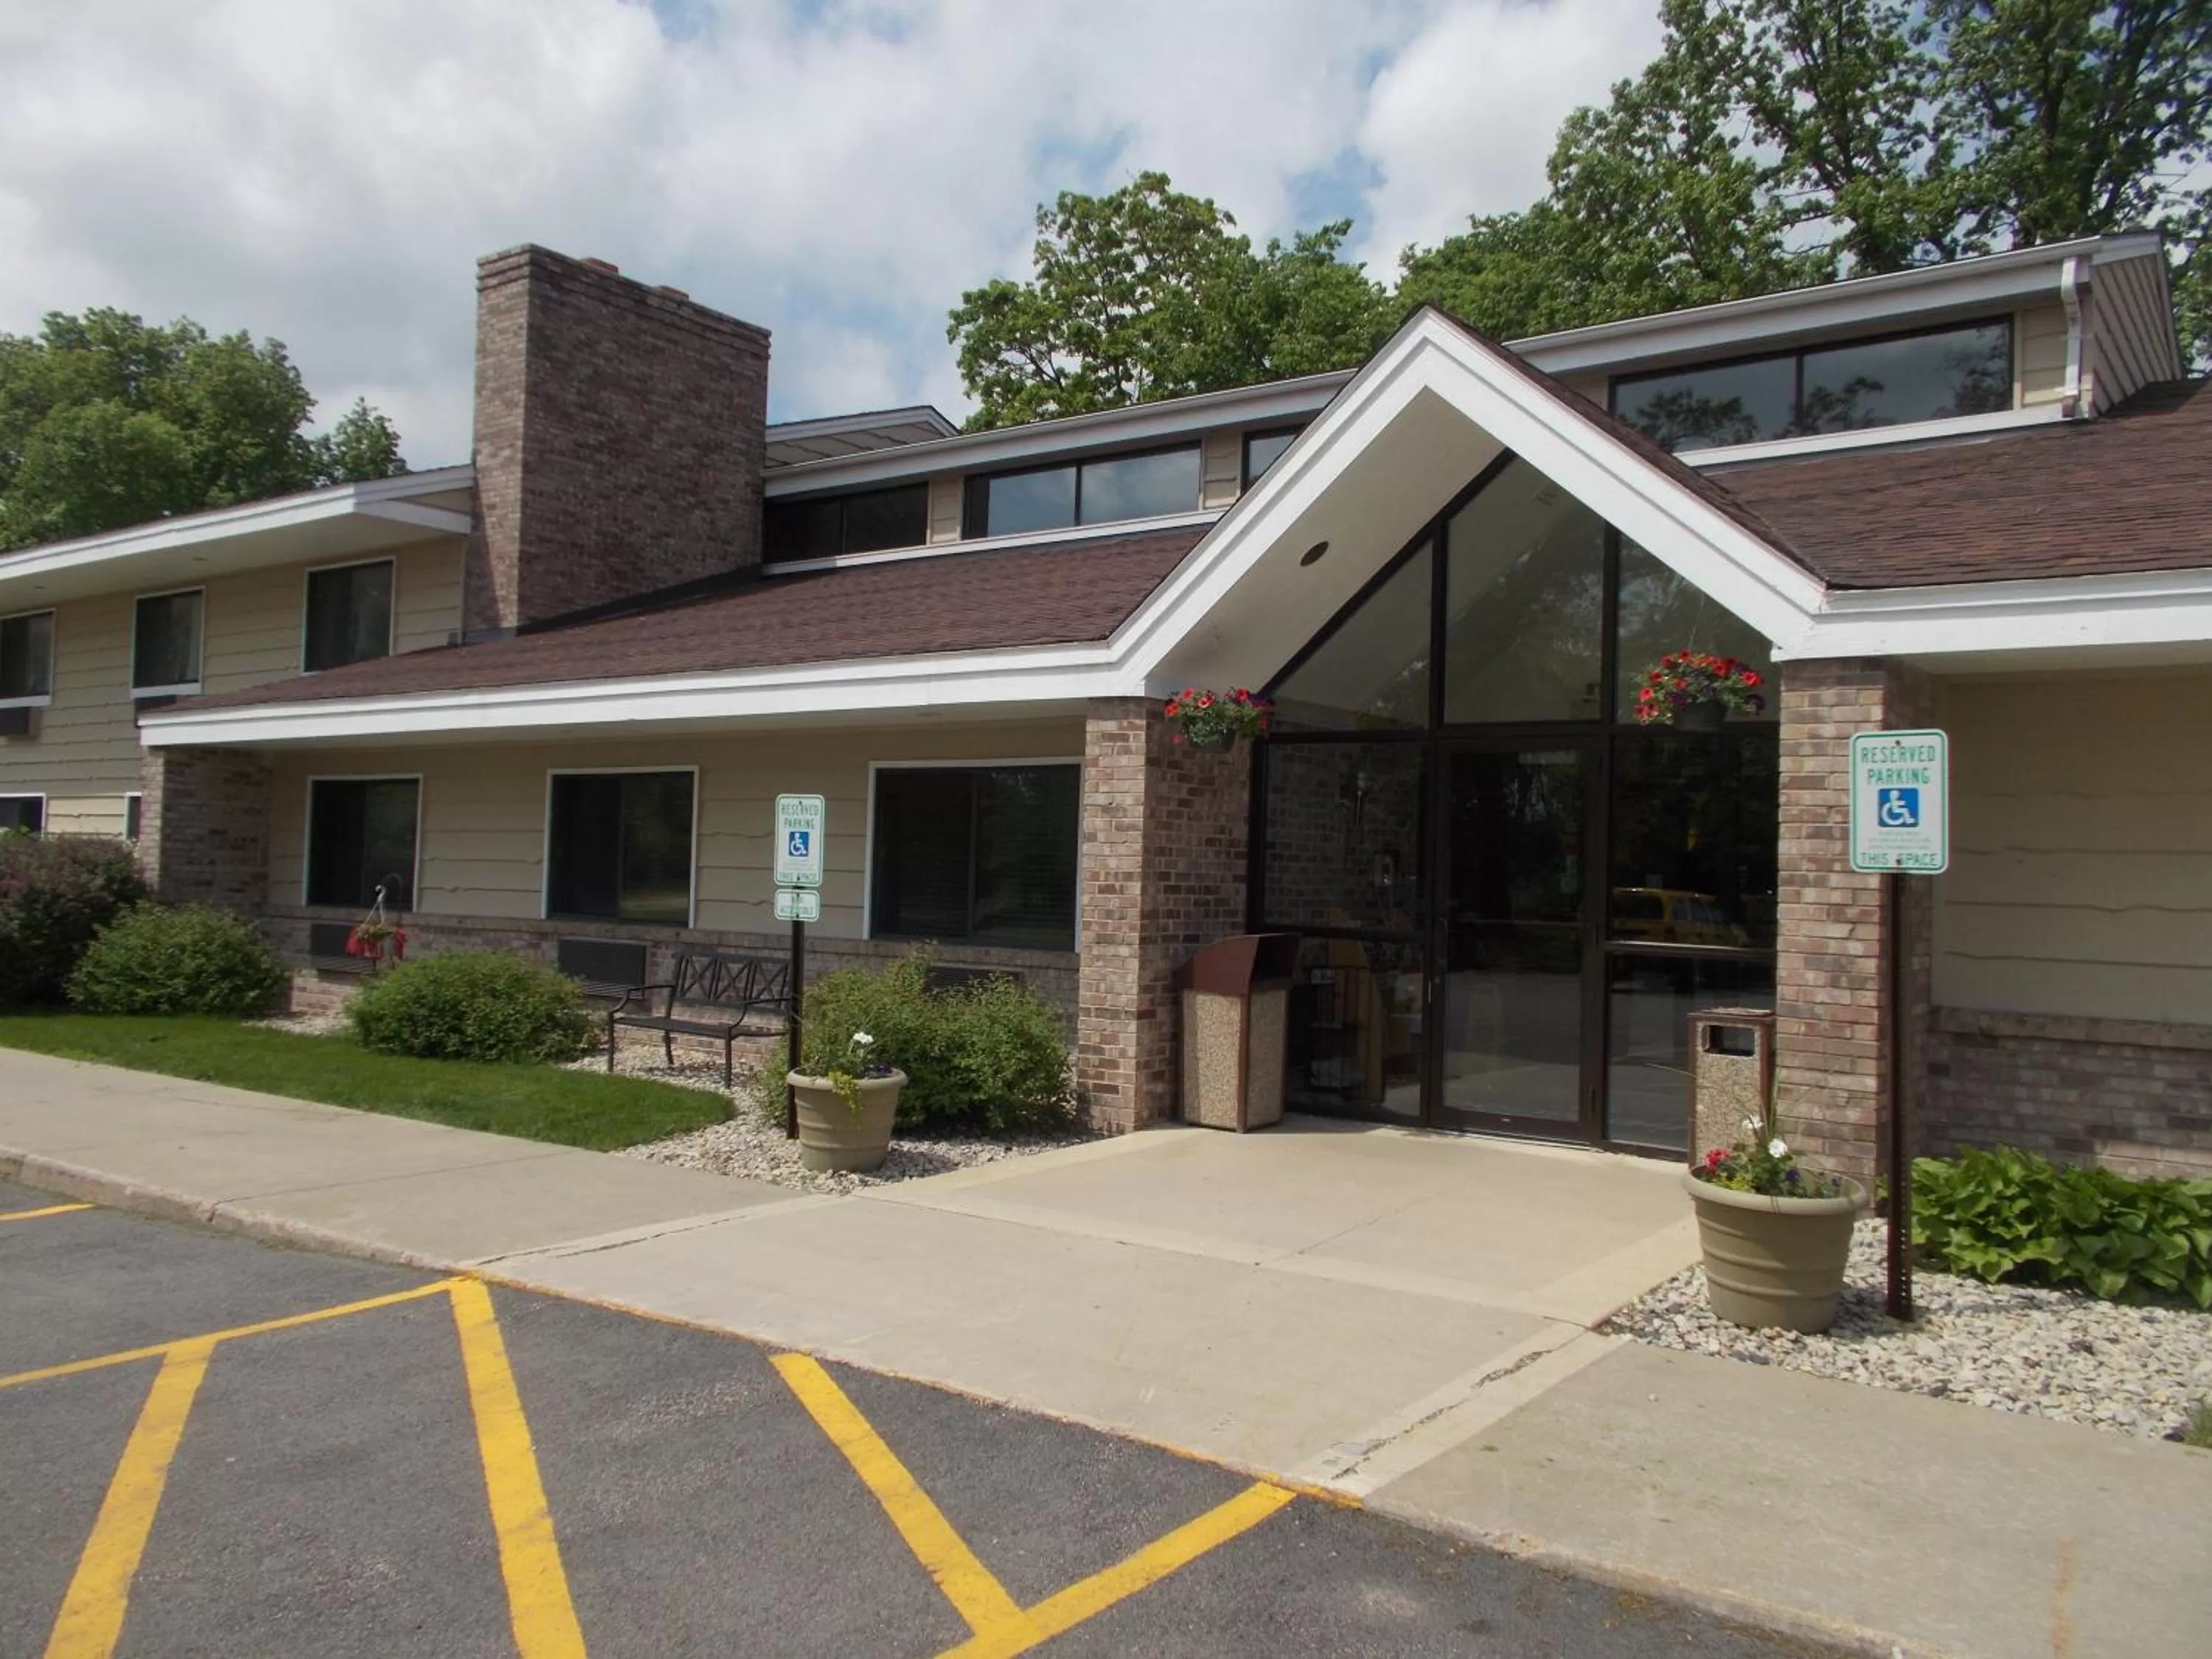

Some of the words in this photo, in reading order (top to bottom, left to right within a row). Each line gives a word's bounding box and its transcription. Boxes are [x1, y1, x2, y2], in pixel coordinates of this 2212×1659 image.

[1861, 745, 1935, 763] RESERVED
[1867, 768, 1930, 785] PARKING
[781, 804, 819, 816] RESERVED
[784, 817, 815, 830] PARKING
[1861, 852, 1889, 865] THIS
[1896, 853, 1938, 866] SPACE
